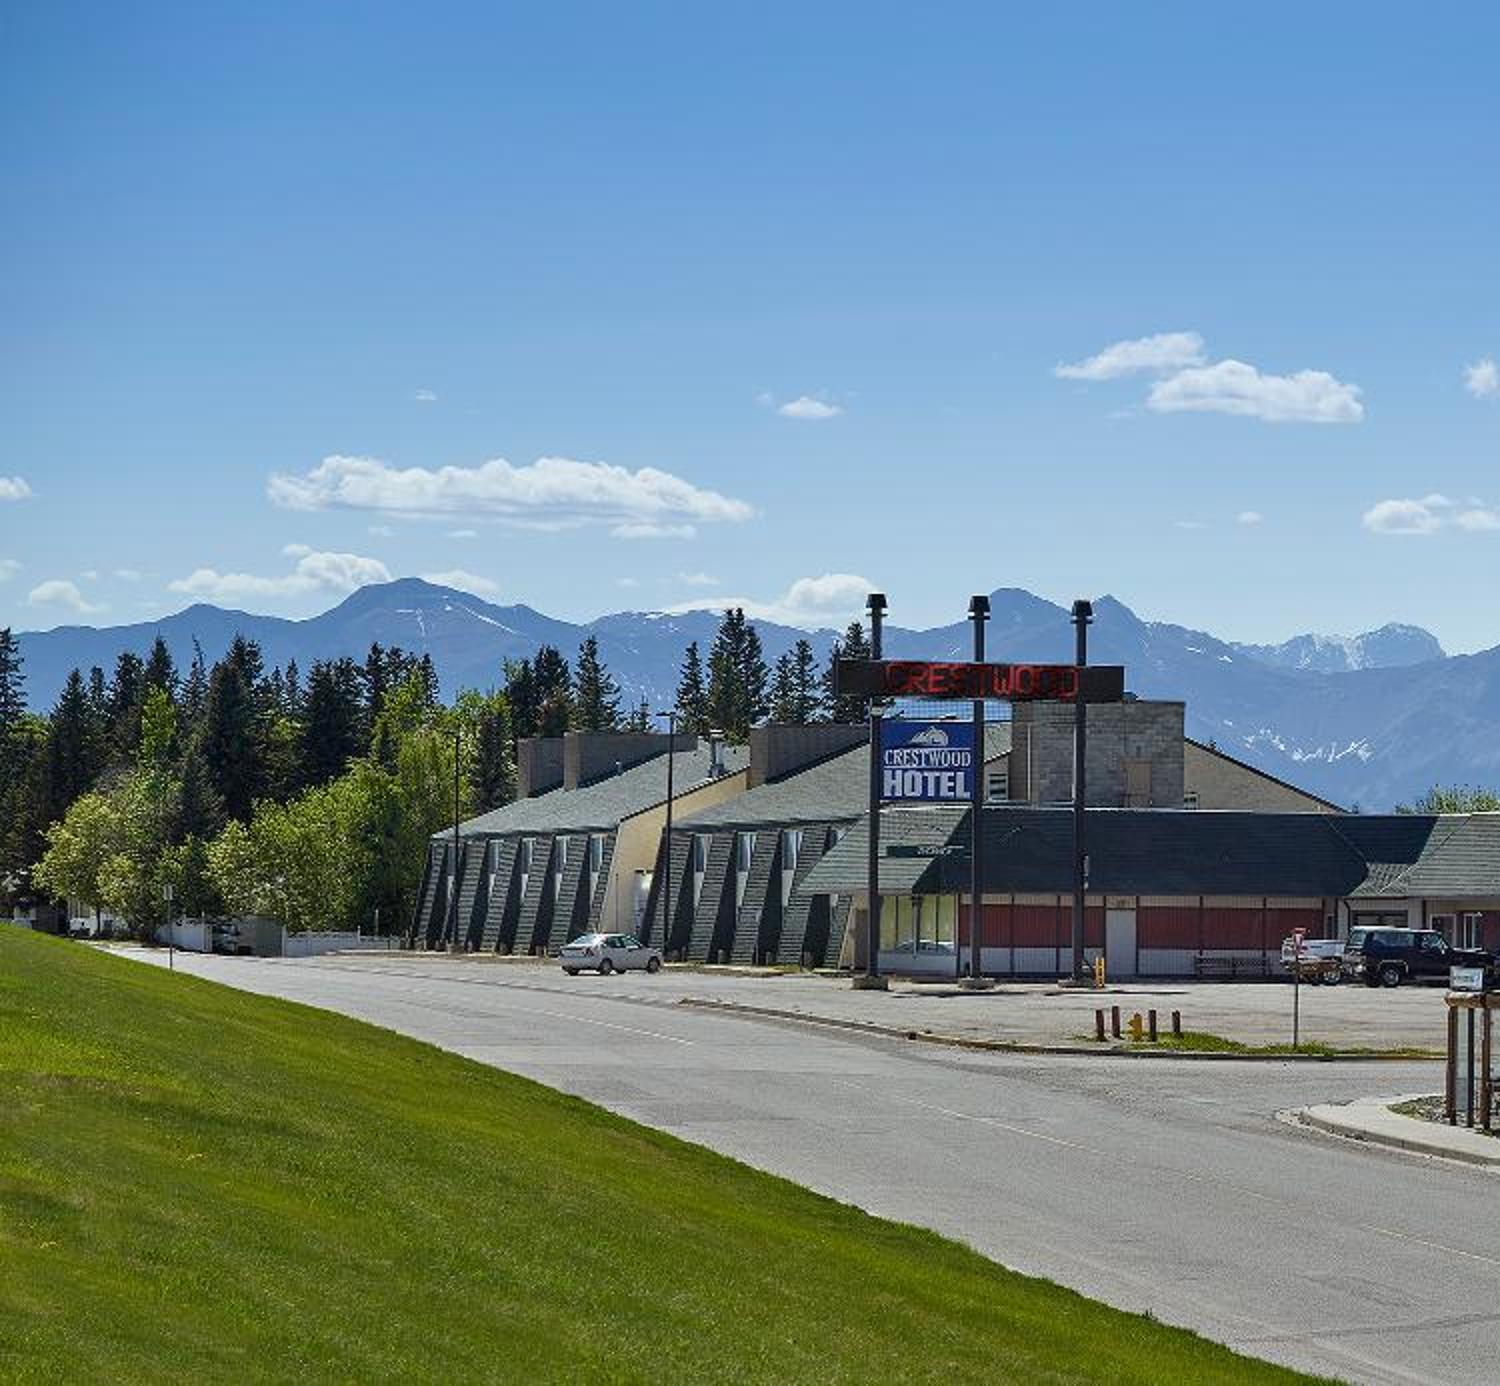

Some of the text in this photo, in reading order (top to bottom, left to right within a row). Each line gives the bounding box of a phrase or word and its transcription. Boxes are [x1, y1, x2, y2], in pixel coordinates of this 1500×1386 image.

[885, 663, 1080, 697] CRESTWOOD
[884, 748, 971, 767] CRESTWOOD
[883, 769, 970, 798] HOTEL
